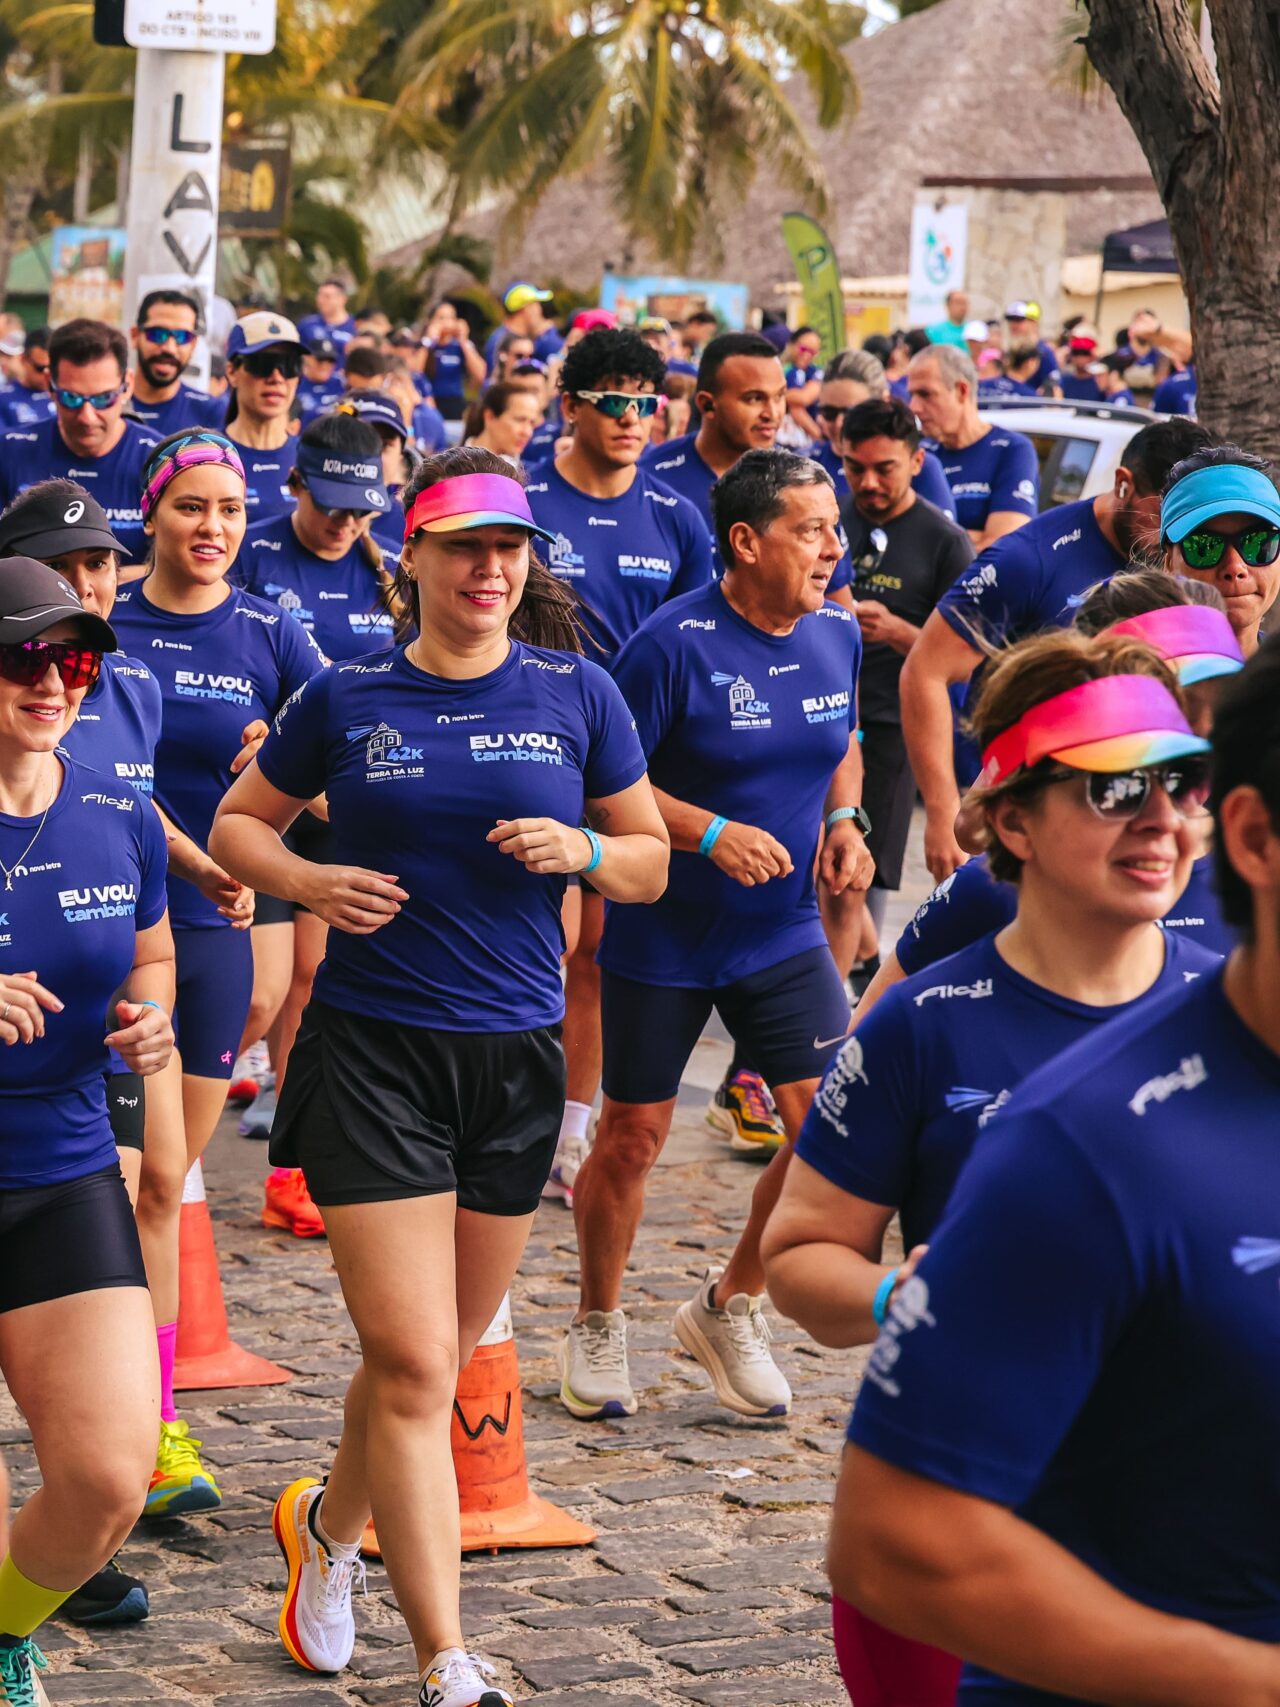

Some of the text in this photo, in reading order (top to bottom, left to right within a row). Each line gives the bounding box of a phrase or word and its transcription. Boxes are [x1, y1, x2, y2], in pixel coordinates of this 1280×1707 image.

[175, 670, 254, 697] EU VOU,
[745, 700, 771, 714] 42K
[802, 697, 825, 713] EU
[469, 732, 562, 755] EU VOU,
[386, 746, 425, 761] 42K
[114, 762, 135, 777] EU
[366, 767, 425, 780] TERRA DA LUZ
[29, 862, 62, 873] nova letra
[58, 883, 136, 908] EU VOU,
[1165, 916, 1206, 927] nova letra
